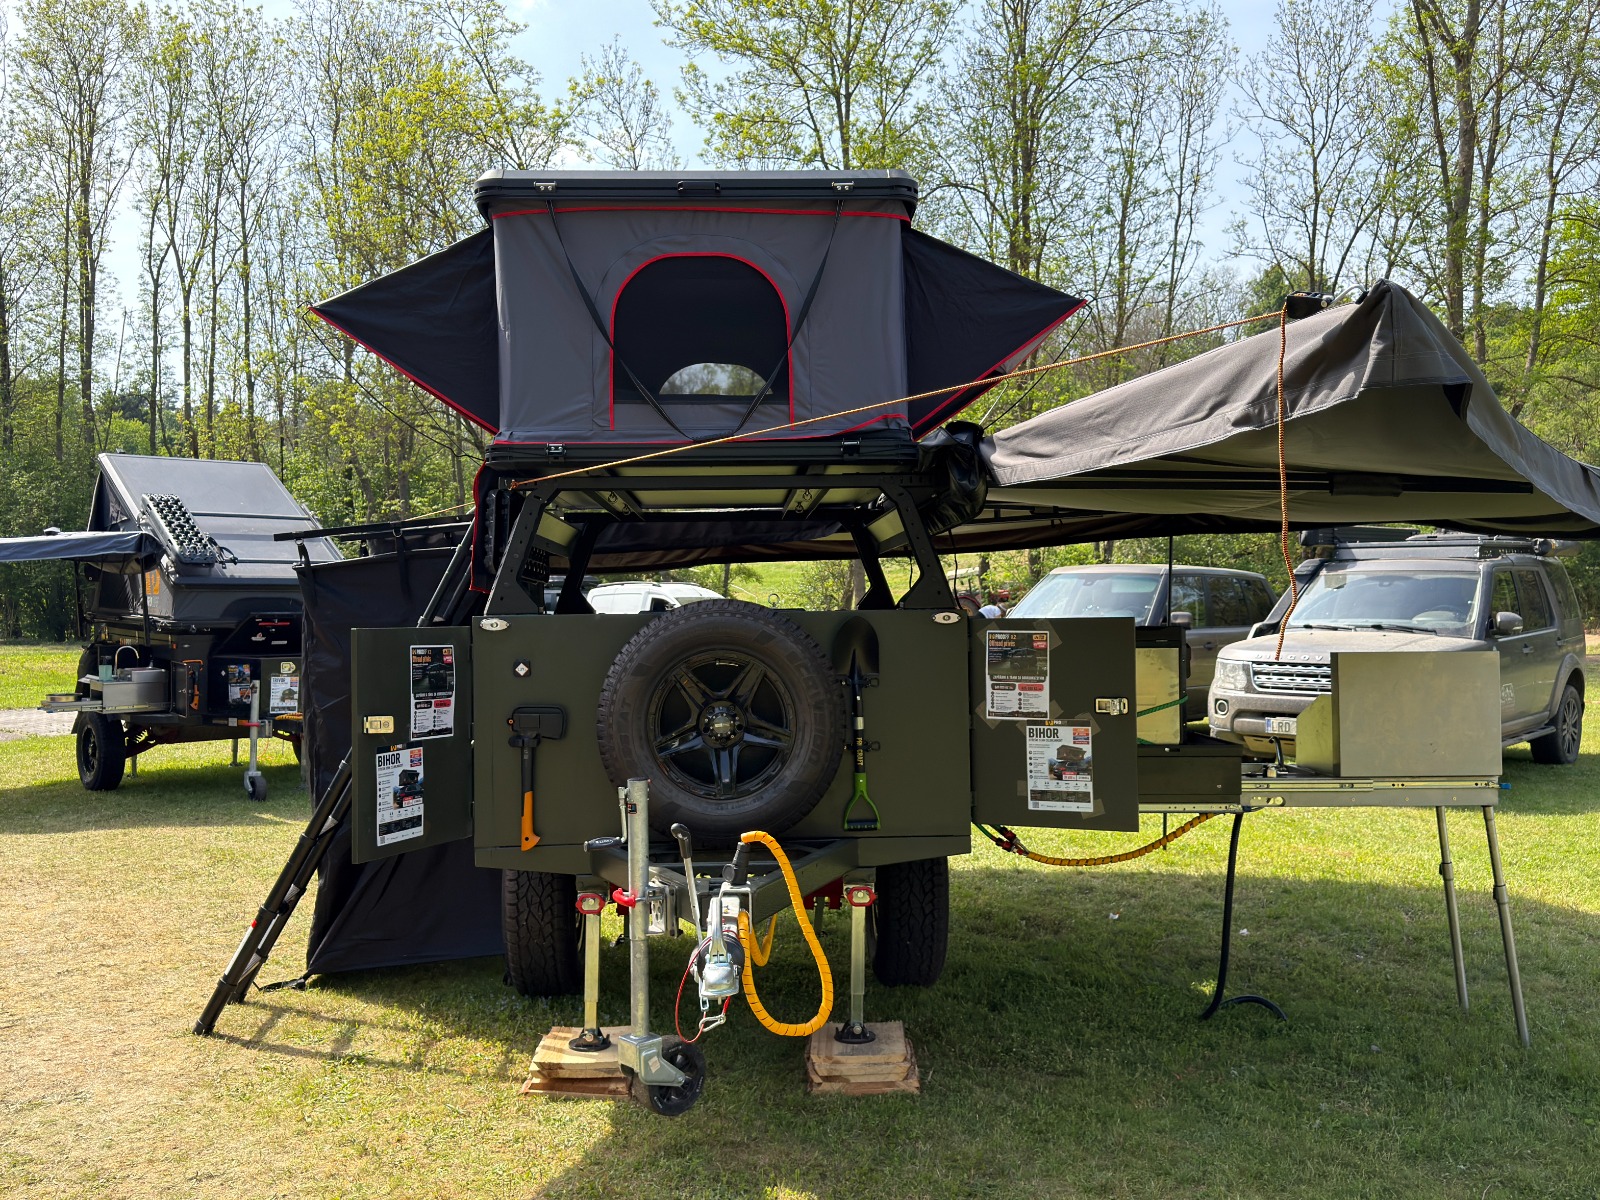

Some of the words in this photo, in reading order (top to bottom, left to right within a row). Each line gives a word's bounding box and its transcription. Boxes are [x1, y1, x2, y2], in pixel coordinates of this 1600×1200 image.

[1028, 727, 1060, 739] BIHOR
[1272, 721, 1291, 733] LRD
[377, 752, 401, 768] BIHOR
